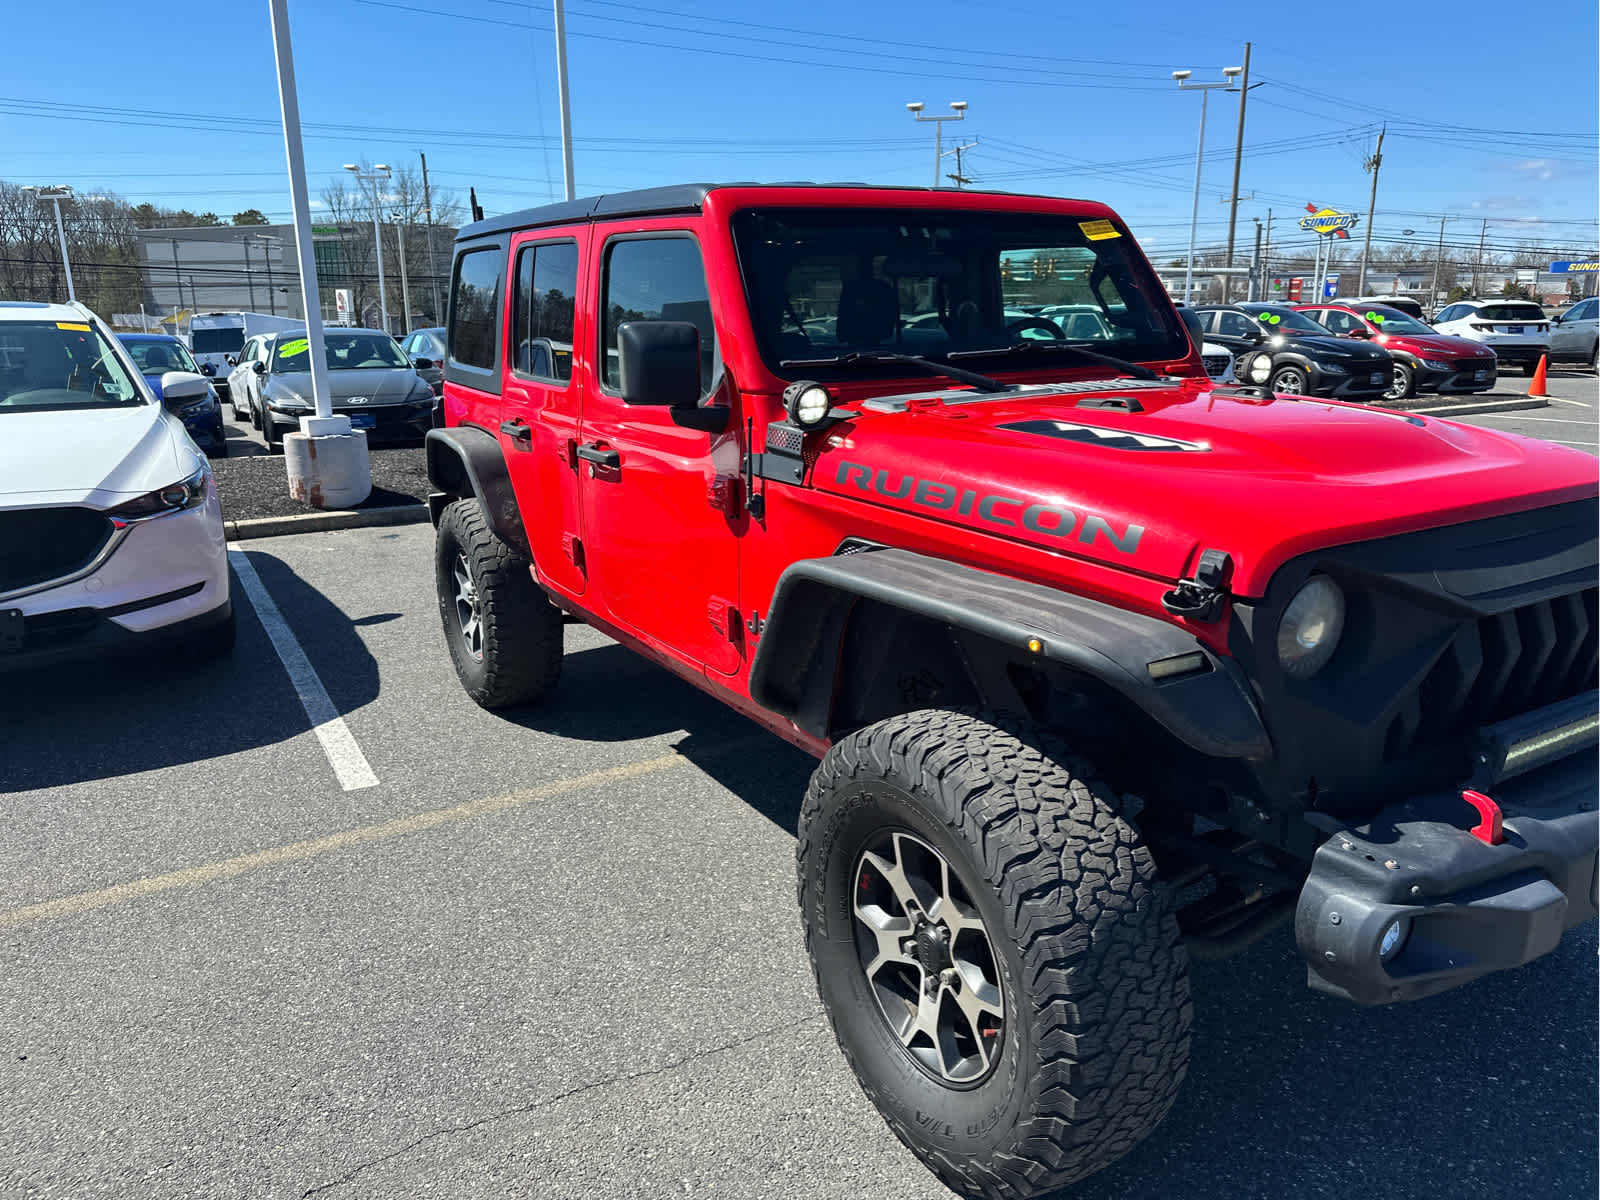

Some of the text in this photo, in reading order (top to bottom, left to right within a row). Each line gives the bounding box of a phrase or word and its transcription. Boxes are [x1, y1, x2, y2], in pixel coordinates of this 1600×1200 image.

[1303, 215, 1350, 229] SUNOCO
[1567, 263, 1599, 271] SUNO
[835, 461, 1145, 554] RUBICON
